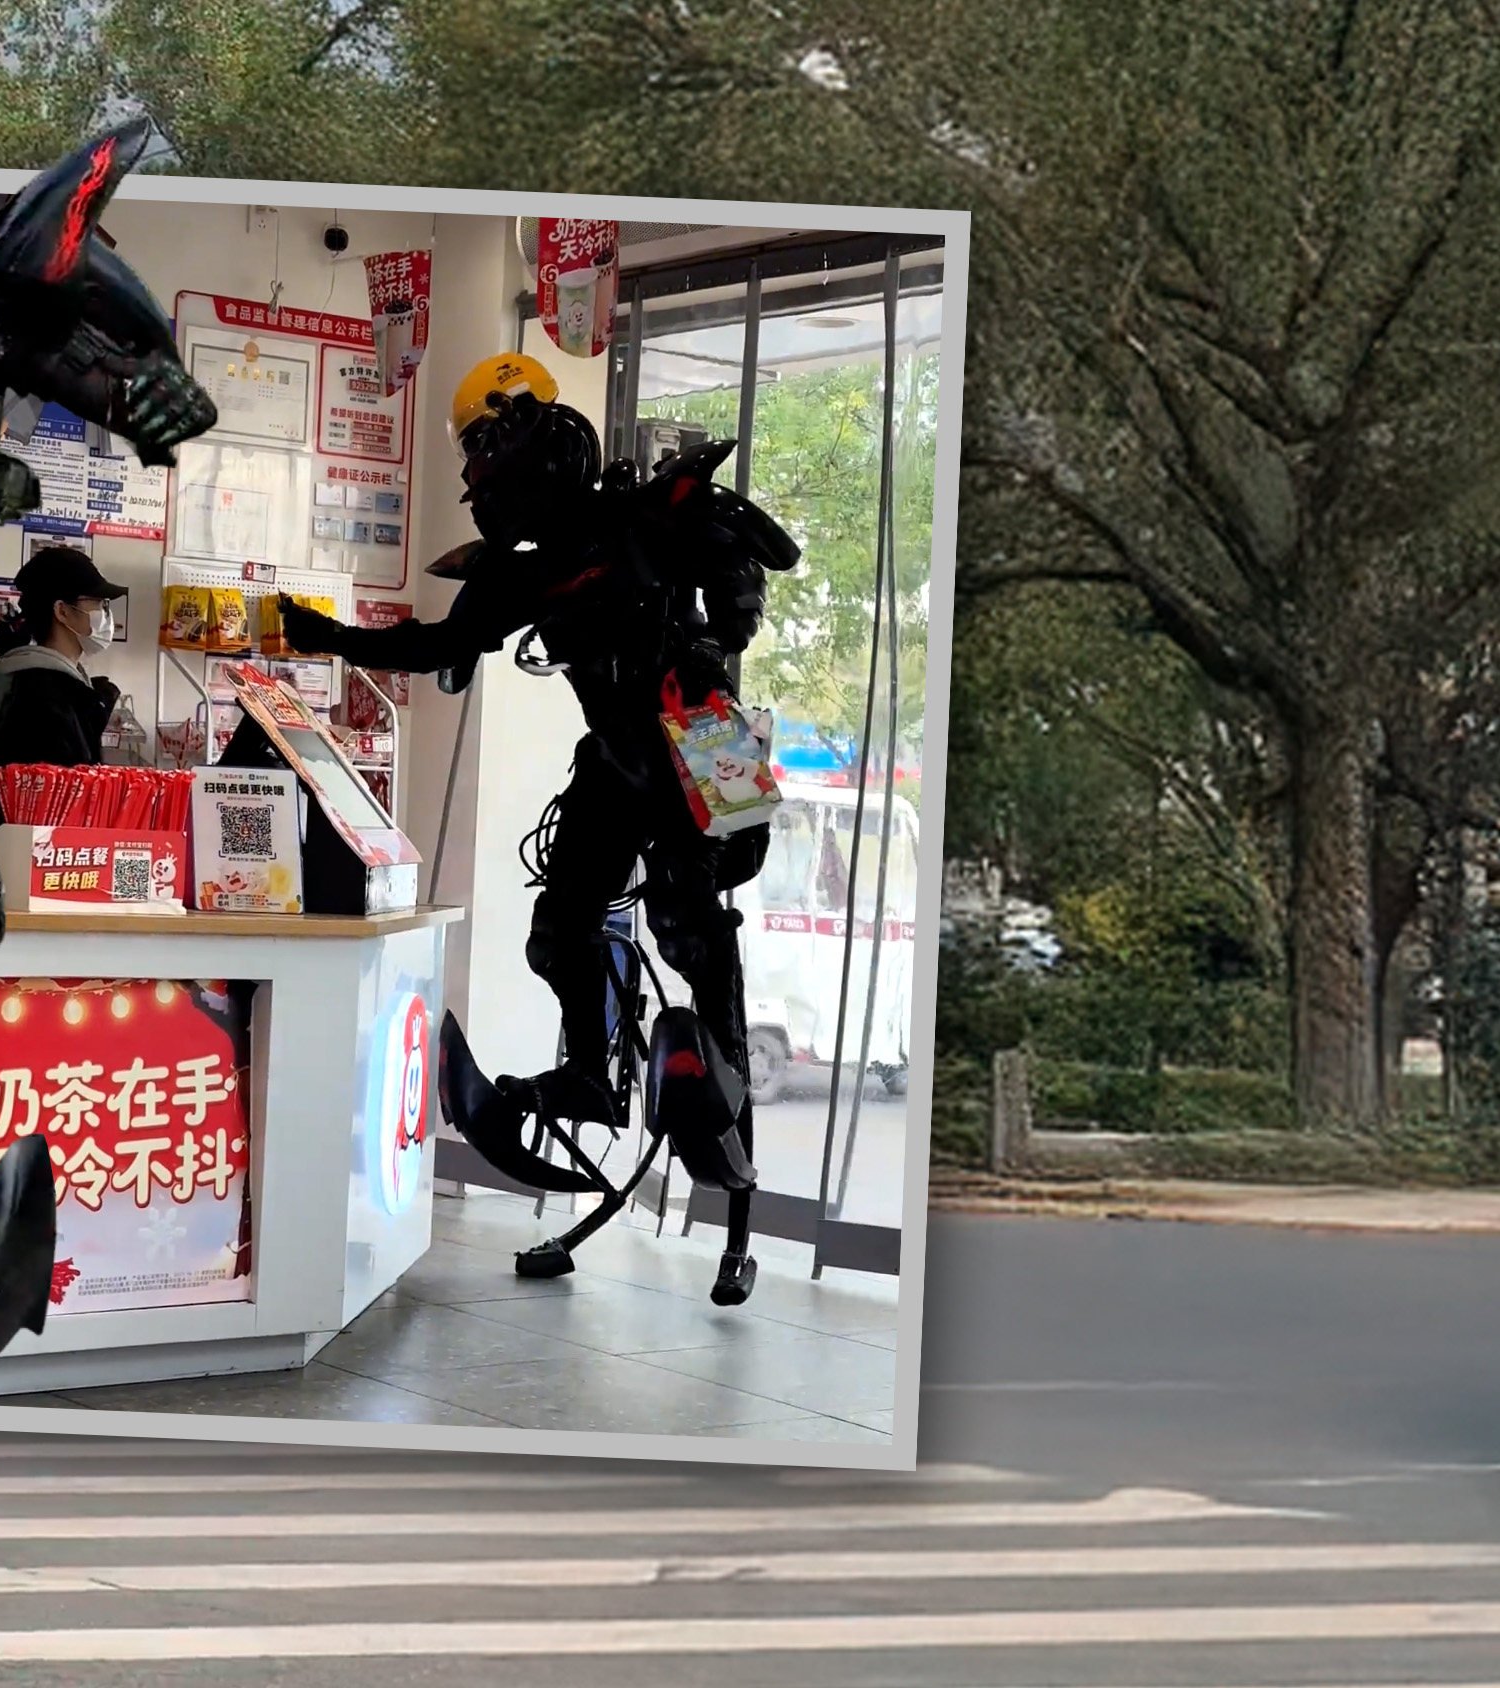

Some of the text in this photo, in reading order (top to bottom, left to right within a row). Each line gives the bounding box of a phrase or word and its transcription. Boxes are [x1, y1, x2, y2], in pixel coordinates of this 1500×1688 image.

[224, 302, 373, 341] 食品监督管理信息公示栏
[326, 466, 393, 486] 健康证公示栏
[204, 782, 285, 797] 扫码点餐更快哦
[35, 846, 111, 868] 扫码点餐
[42, 870, 100, 892] 更快哦
